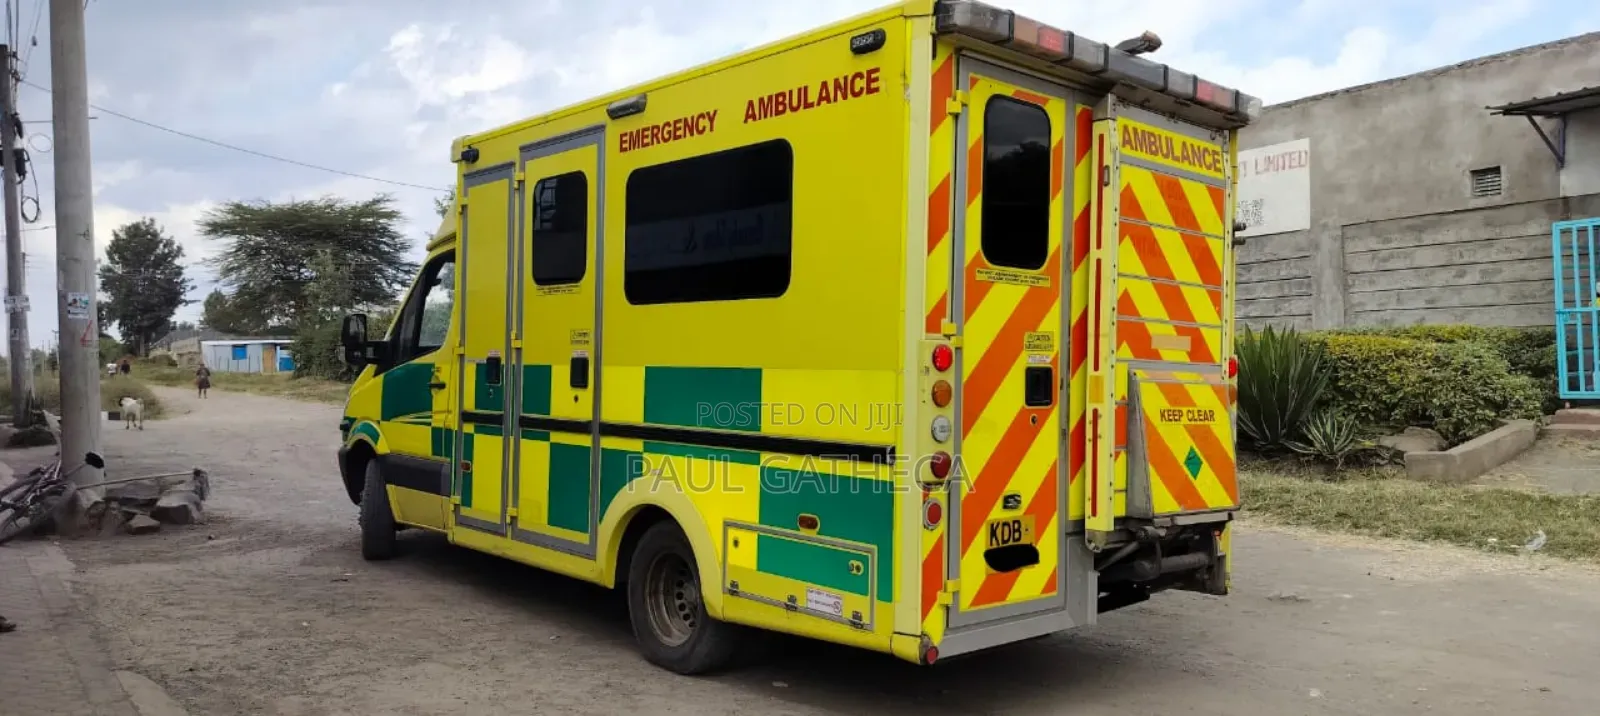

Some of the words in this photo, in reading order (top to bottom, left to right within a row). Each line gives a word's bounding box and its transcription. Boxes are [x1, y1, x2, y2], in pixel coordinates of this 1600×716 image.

[619, 109, 718, 153] EMERGENCY
[743, 67, 881, 124] AMBULANCE
[1121, 124, 1222, 174] AMBULANCE
[1254, 149, 1309, 176] LIMITED
[1159, 408, 1183, 422] KEEP
[1186, 409, 1216, 422] CLEAR
[989, 519, 1022, 547] KDB
